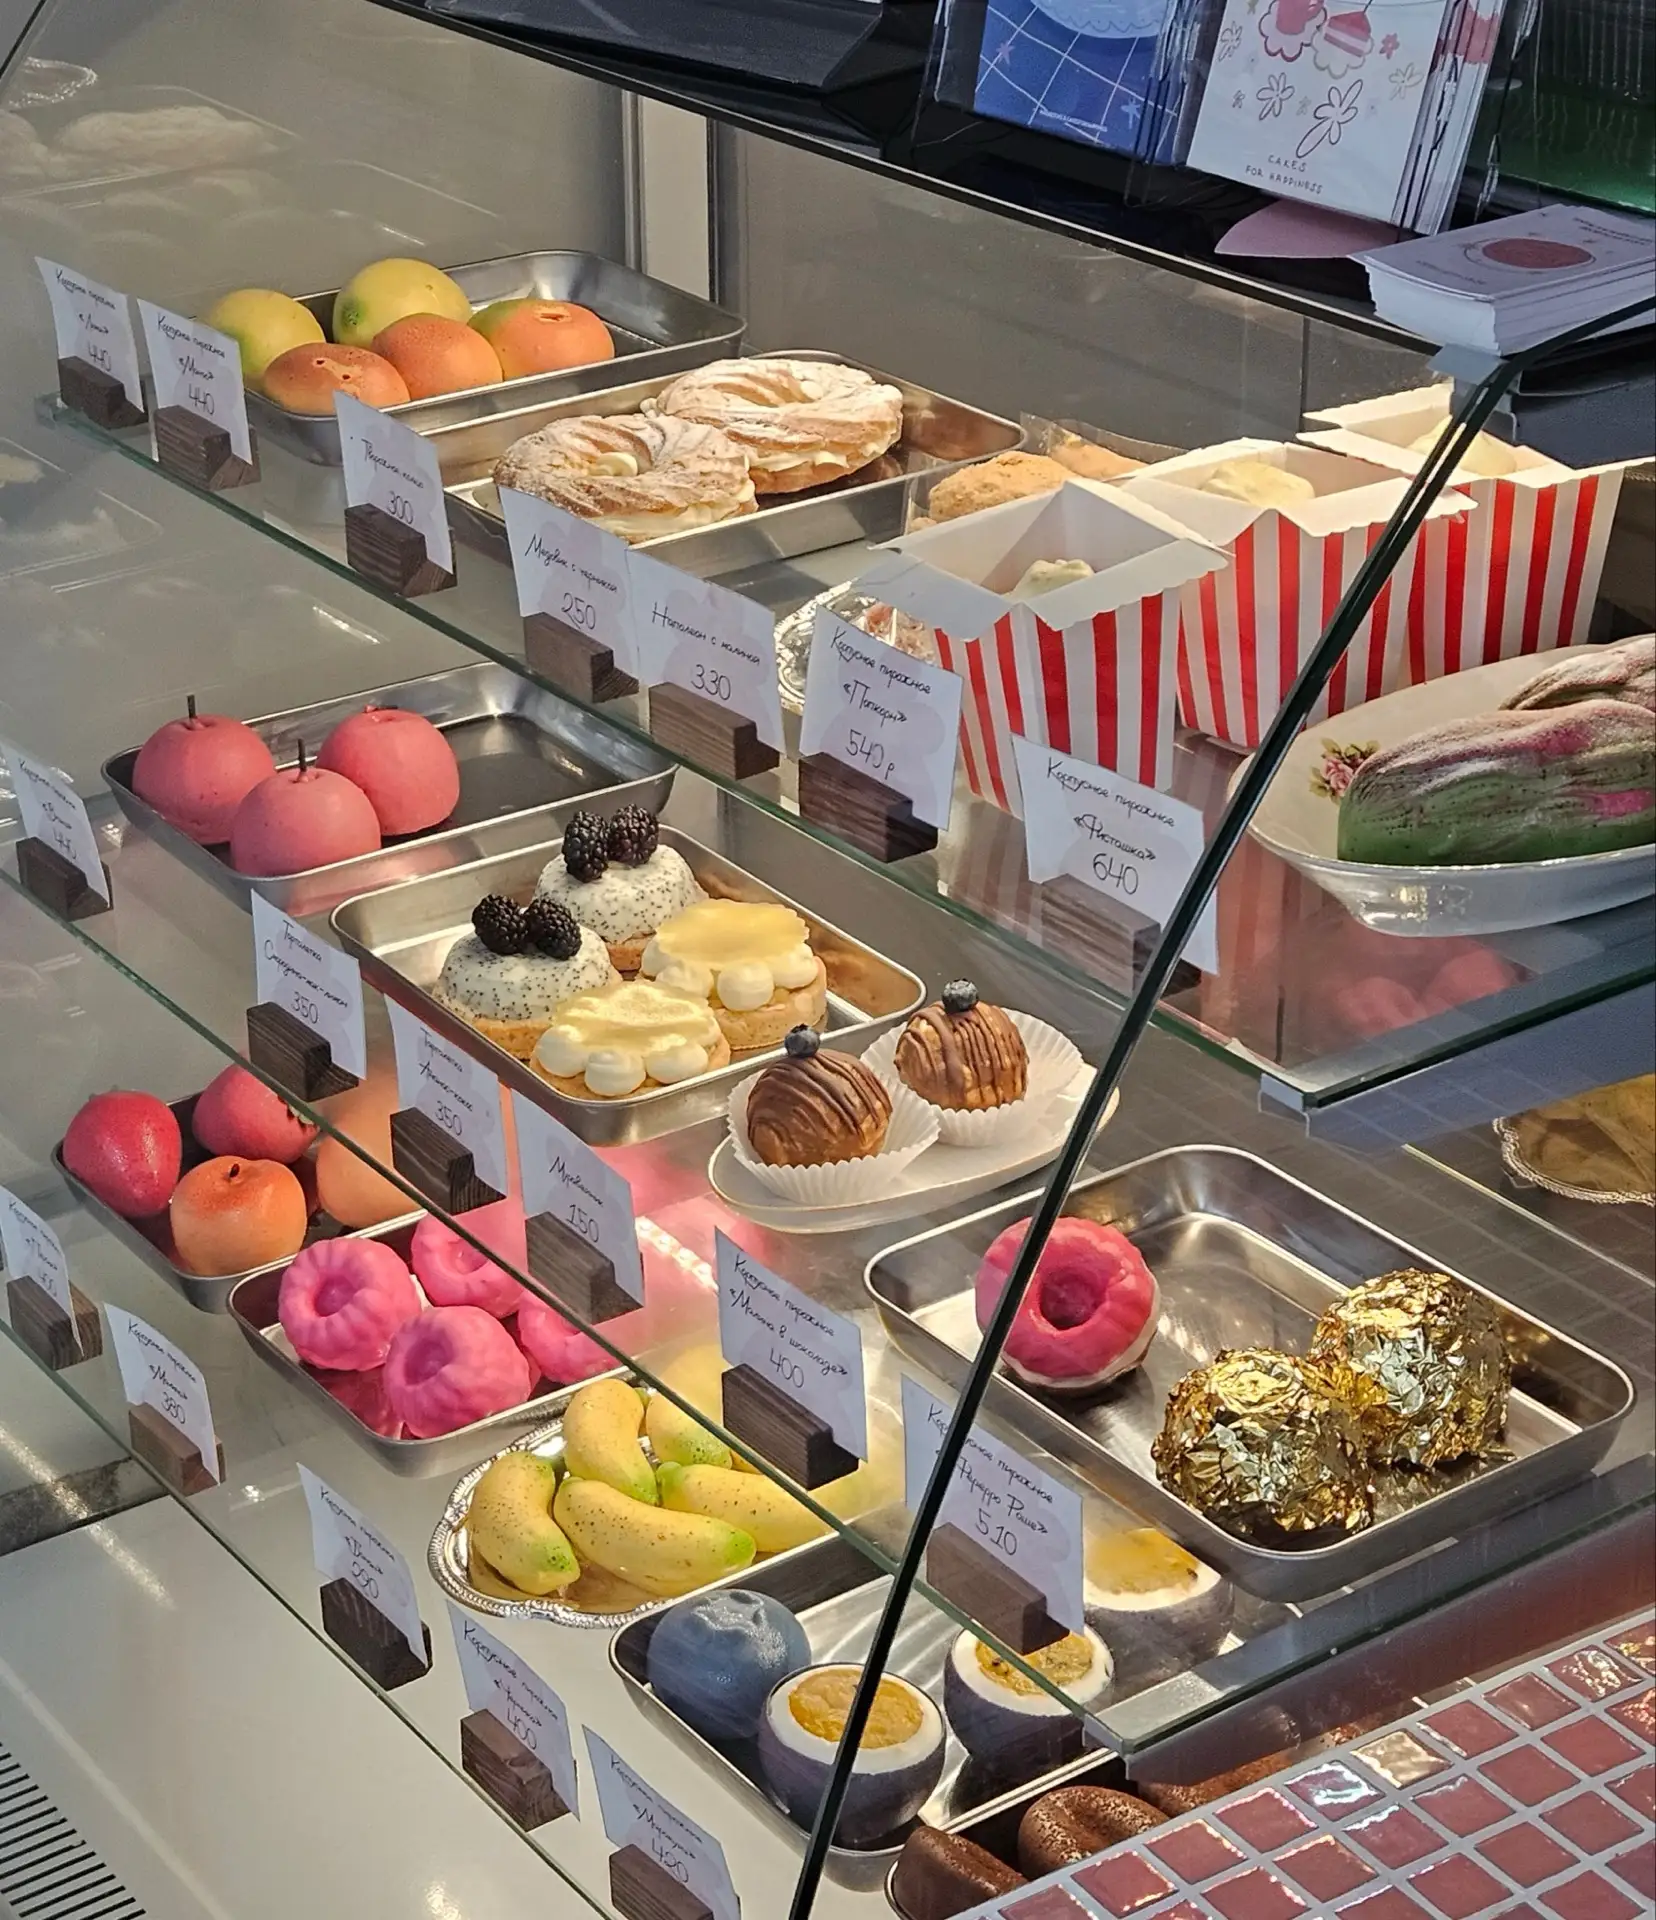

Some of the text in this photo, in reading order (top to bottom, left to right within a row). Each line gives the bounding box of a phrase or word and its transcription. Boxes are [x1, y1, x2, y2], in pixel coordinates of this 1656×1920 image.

[1245, 164, 1323, 195] FOR HAPPINESS
[1267, 154, 1307, 172] CAKES
[188, 383, 215, 416] 440
[386, 490, 414, 525] 300
[561, 592, 597, 630] 250
[652, 601, 707, 640] Наполеон
[690, 663, 732, 701] 330
[879, 663, 931, 695] пирожное
[845, 728, 885, 769] 540
[1115, 793, 1175, 828] пирожное
[1093, 853, 1139, 895] 640
[291, 991, 319, 1024] 350
[434, 1100, 463, 1136] 350
[566, 1203, 600, 1243] 150
[769, 1347, 804, 1388] 400
[997, 1459, 1053, 1504] пирожное
[975, 1508, 1018, 1556] 510
[507, 1706, 538, 1750] 400
